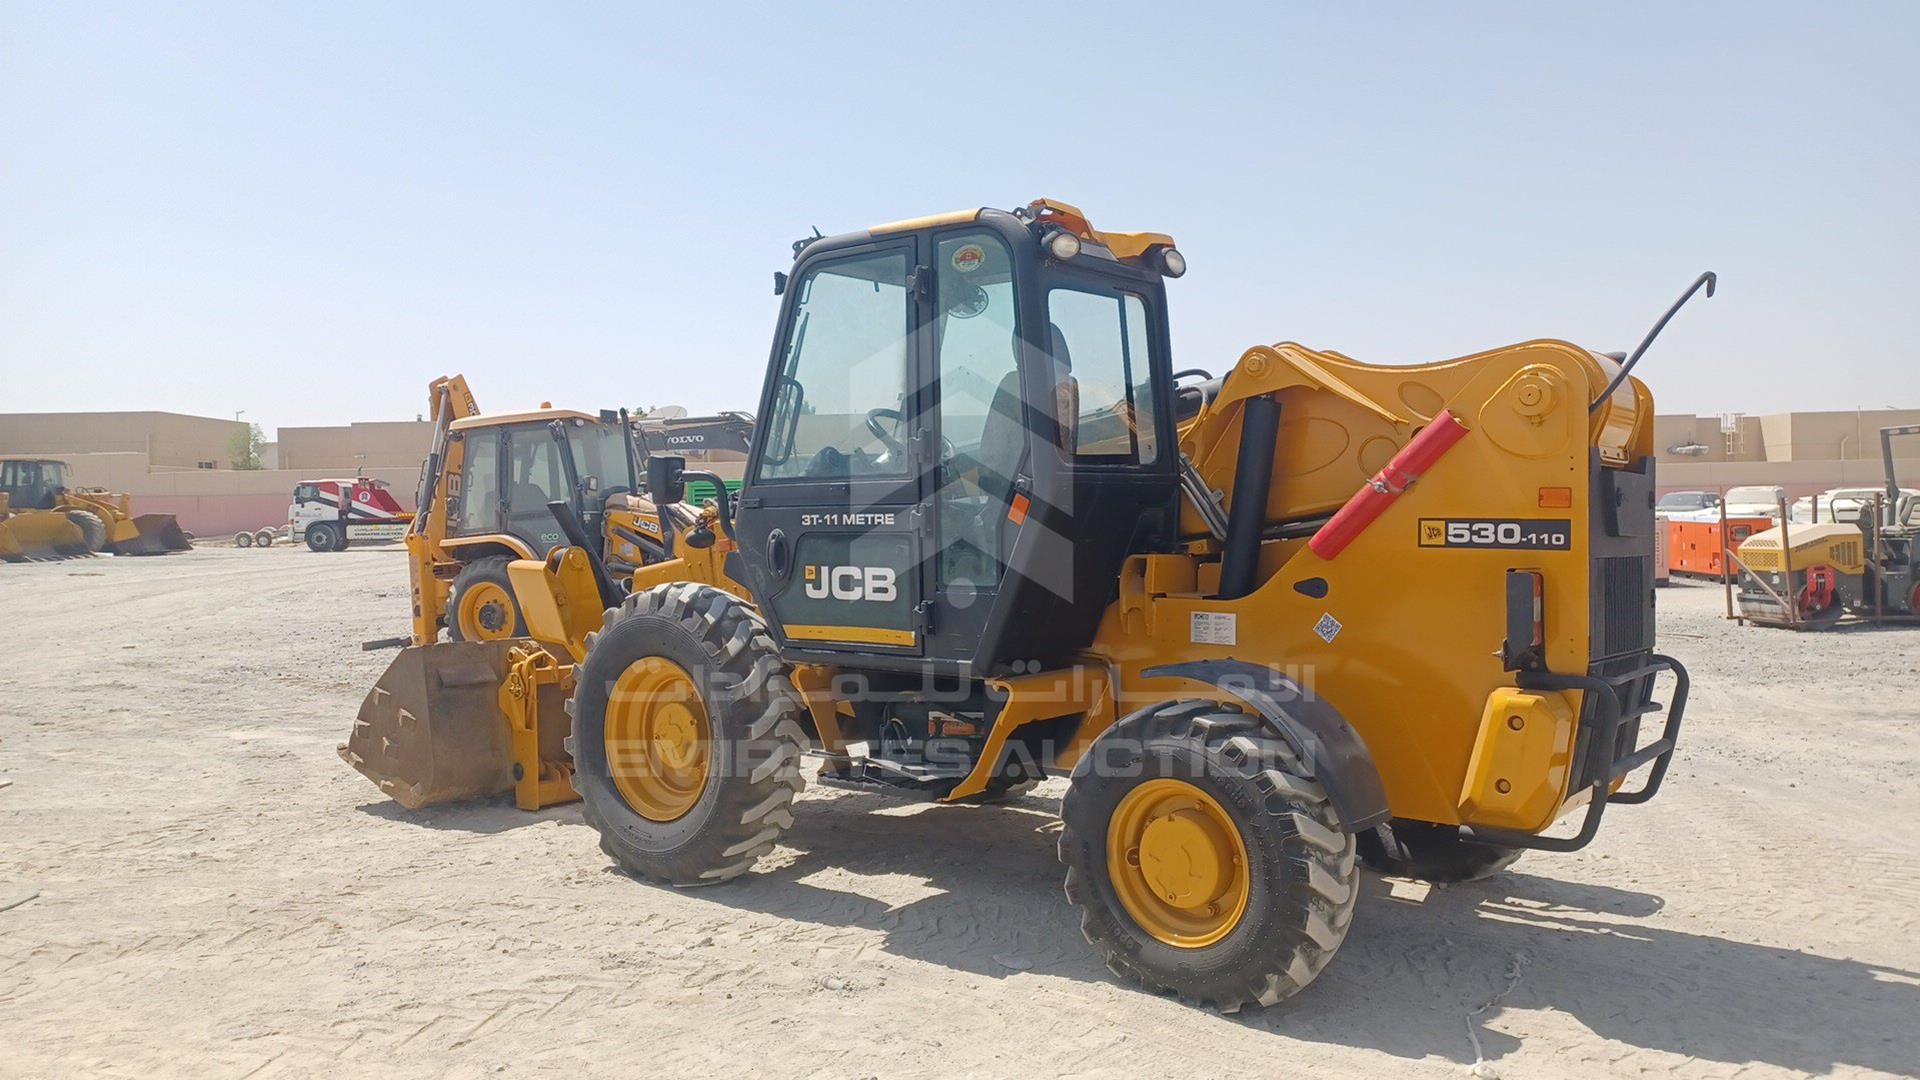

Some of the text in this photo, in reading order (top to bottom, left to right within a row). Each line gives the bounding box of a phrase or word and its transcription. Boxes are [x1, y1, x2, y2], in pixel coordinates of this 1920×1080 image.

[632, 515, 660, 533] JCB
[801, 513, 895, 526] 3T-11 METRE
[1447, 522, 1565, 545] 530-110
[804, 565, 898, 602] JCB
